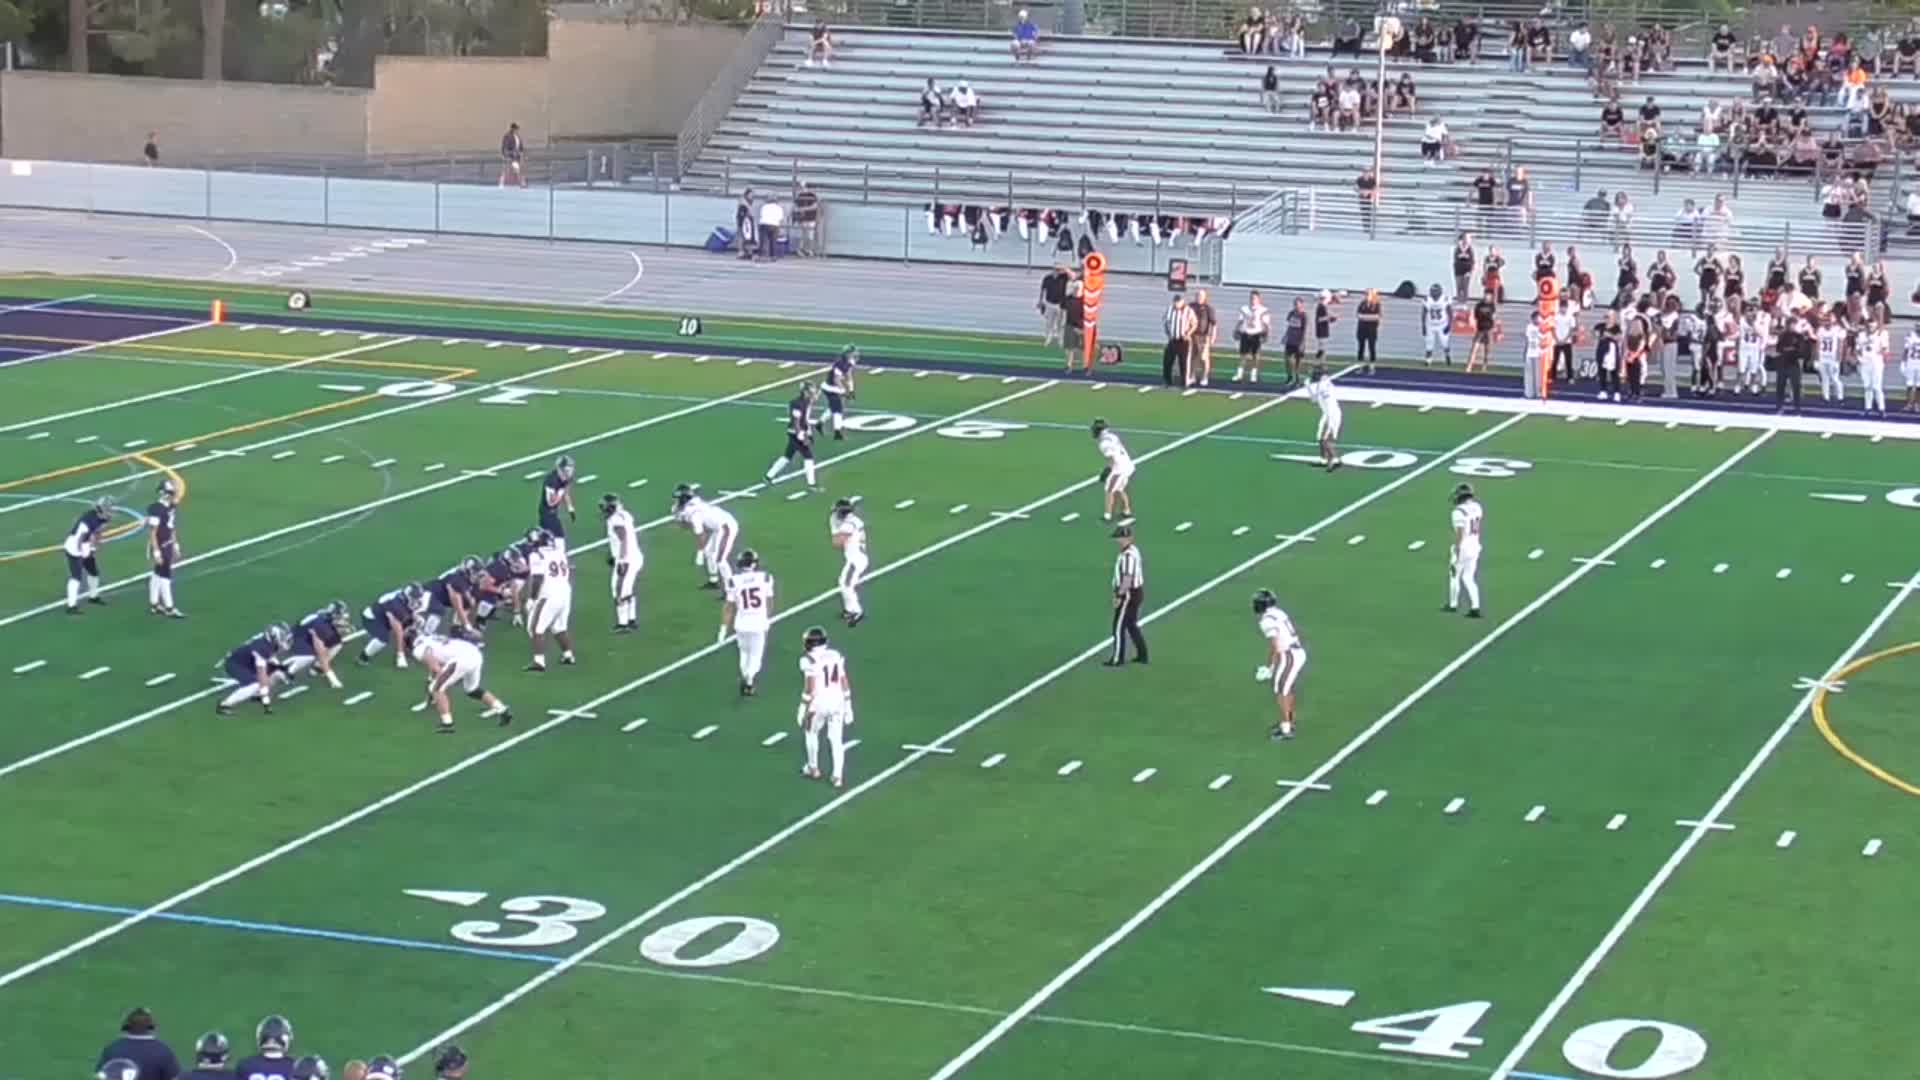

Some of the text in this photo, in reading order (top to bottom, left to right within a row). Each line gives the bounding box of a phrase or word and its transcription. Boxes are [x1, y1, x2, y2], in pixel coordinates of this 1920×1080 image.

[679, 318, 697, 335] 10
[1580, 359, 1598, 378] 30
[741, 587, 761, 609] 15
[824, 663, 839, 688] 14
[450, 896, 779, 967] 30
[1350, 1001, 1708, 1079] 40
